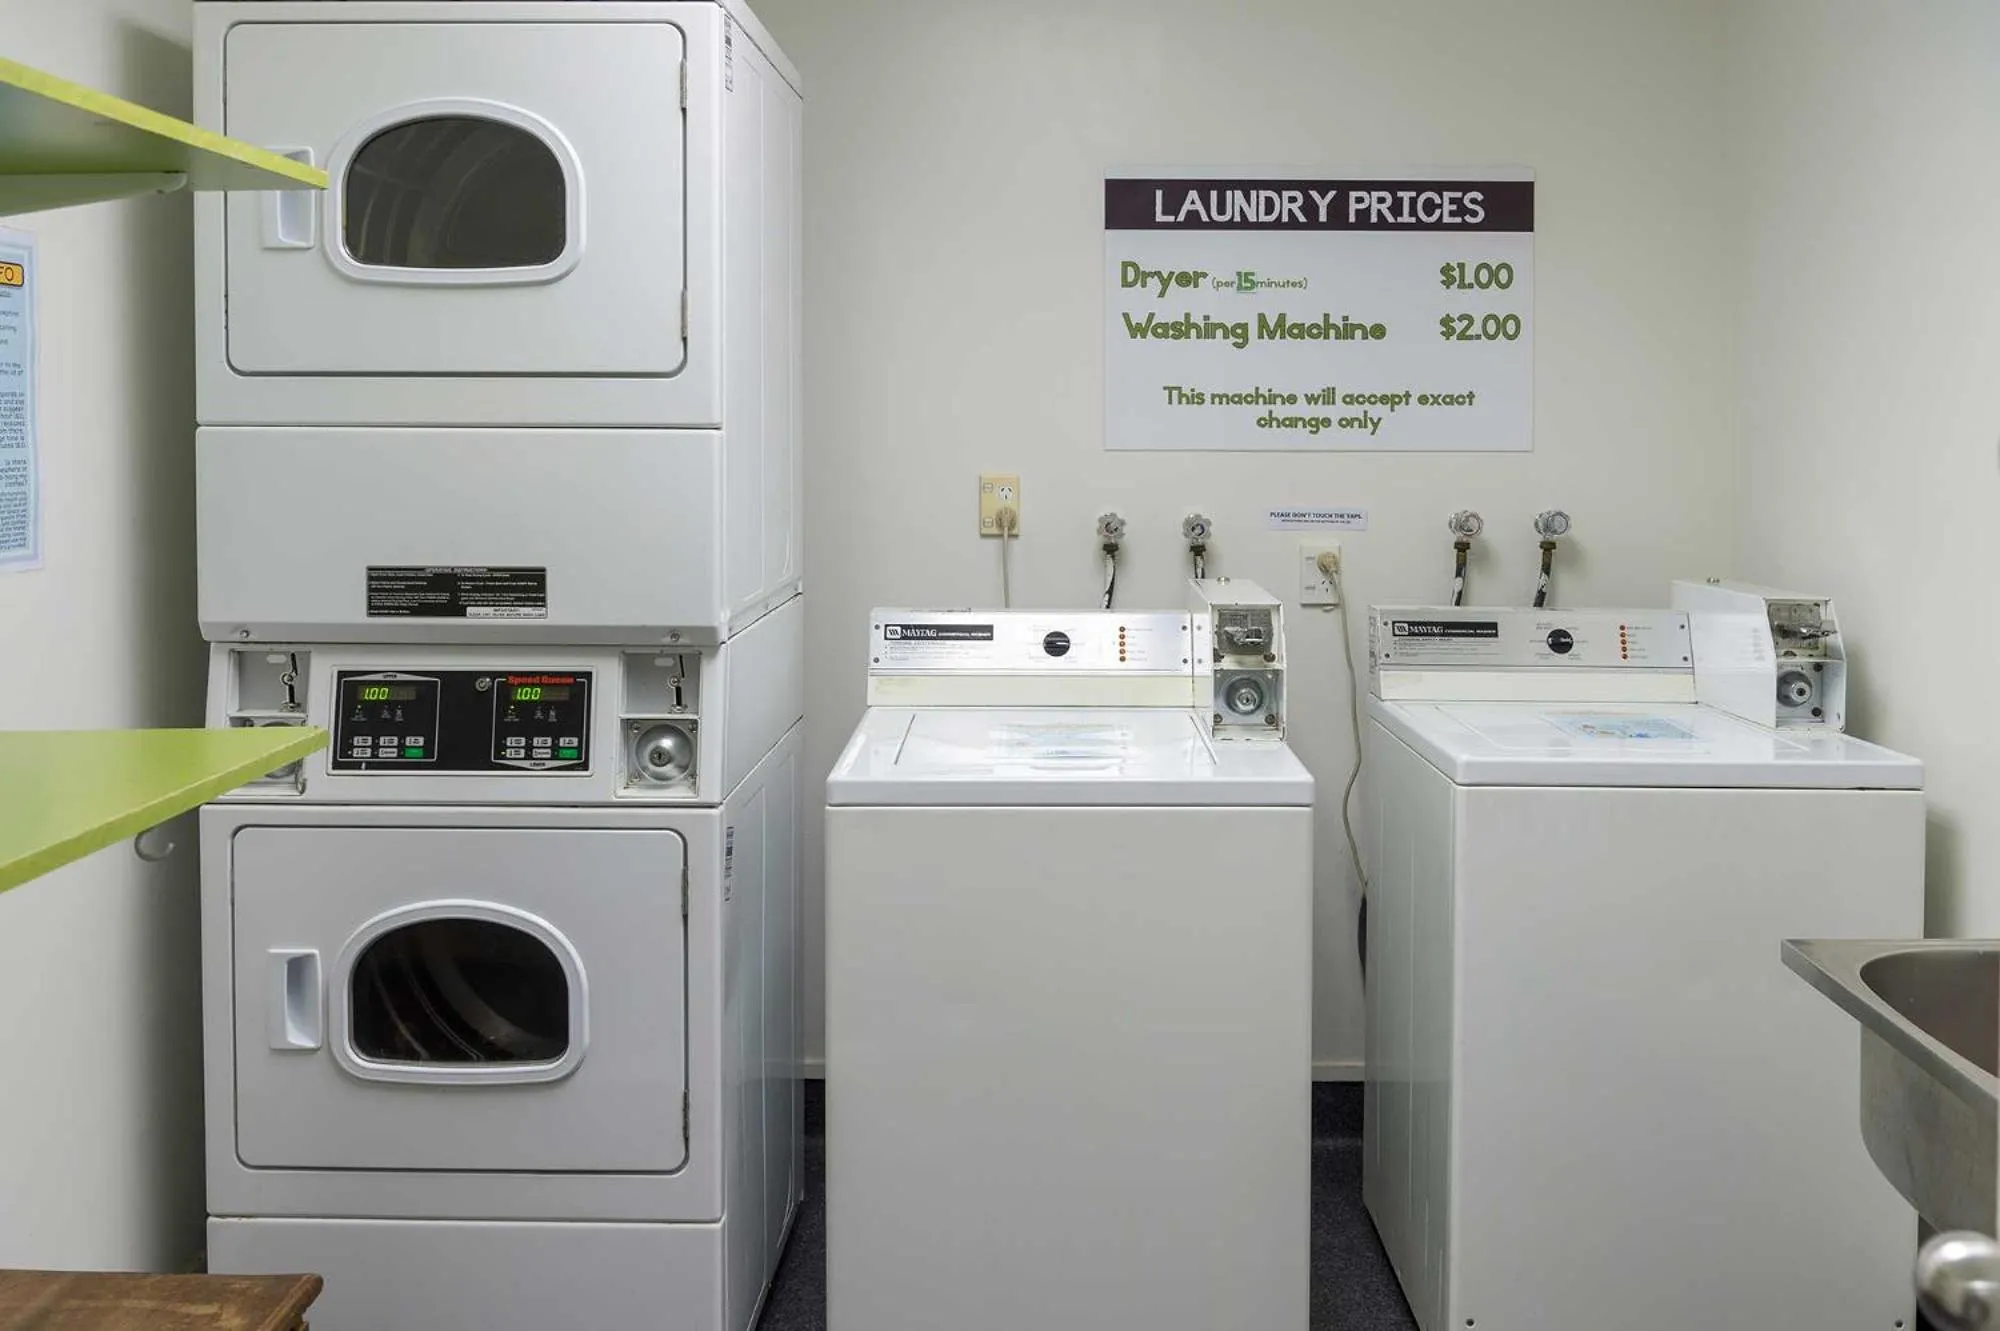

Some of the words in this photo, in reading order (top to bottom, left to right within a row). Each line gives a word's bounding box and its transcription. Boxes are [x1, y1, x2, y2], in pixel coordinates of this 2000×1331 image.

[1155, 189, 1337, 223] LAUNDRY
[1349, 191, 1485, 224] PRICES
[1120, 261, 1209, 298] Dryer
[1236, 271, 1256, 291] 15
[1439, 262, 1514, 290] $1.00
[1122, 312, 1249, 349] Washing
[1257, 312, 1386, 341] Machine
[1439, 313, 1521, 341] $2.00
[1163, 386, 1205, 406] This
[1210, 386, 1297, 406] machine
[1304, 387, 1336, 406] will
[1342, 389, 1411, 412] accept
[1417, 389, 1475, 407] exact
[1256, 410, 1331, 435] change
[1338, 410, 1382, 435] only
[902, 629, 937, 637] MAYTAG
[1409, 625, 1444, 633] MAYTAG
[507, 675, 541, 685] Speed
[364, 687, 389, 700] 1.00
[516, 687, 541, 700] 1.00
